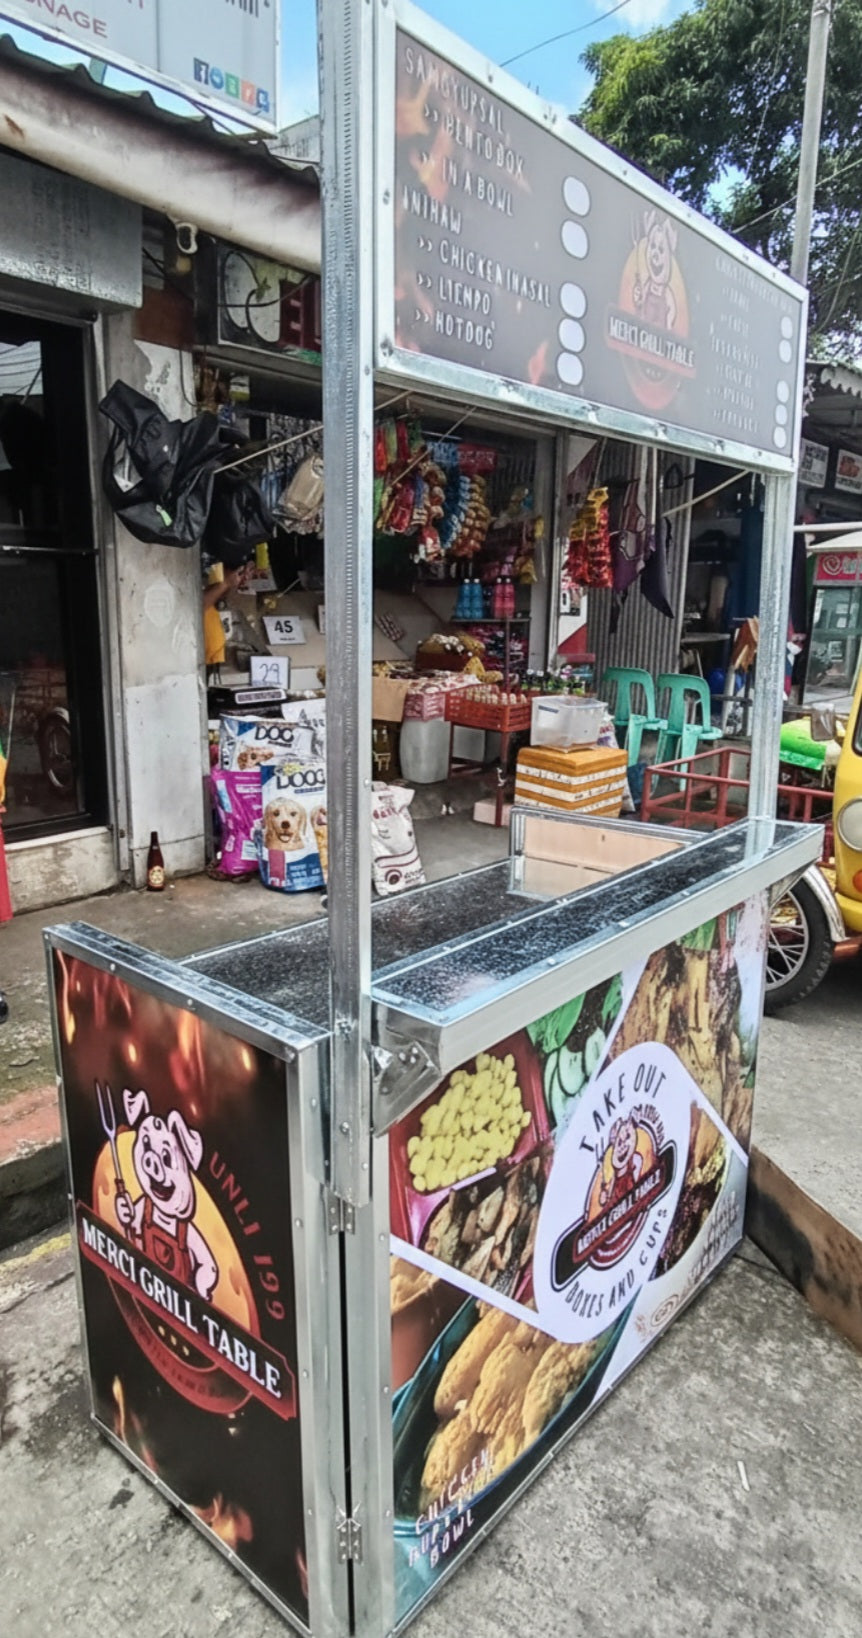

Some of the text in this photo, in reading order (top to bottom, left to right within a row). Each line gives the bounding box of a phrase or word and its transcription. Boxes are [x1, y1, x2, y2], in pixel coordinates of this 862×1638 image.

[30, 0, 108, 38] NAGE
[405, 47, 504, 135] SAMGYUPSAL
[446, 115, 524, 178] BENTO BOX
[442, 157, 514, 217] IN A BOWL
[439, 239, 503, 286] CHICKEN
[435, 310, 493, 350] HOTDOG
[274, 620, 294, 633] 45
[578, 1072, 625, 1153] TAKE
[634, 1062, 667, 1098] OUT
[209, 1151, 285, 1320] UNLI 199
[82, 1216, 137, 1283] MERCI
[139, 1268, 199, 1334] GRILL
[202, 1314, 282, 1399] TABLE
[565, 1280, 605, 1319] BOXES
[609, 1268, 635, 1309] AND
[430, 1508, 474, 1569] BOWL
